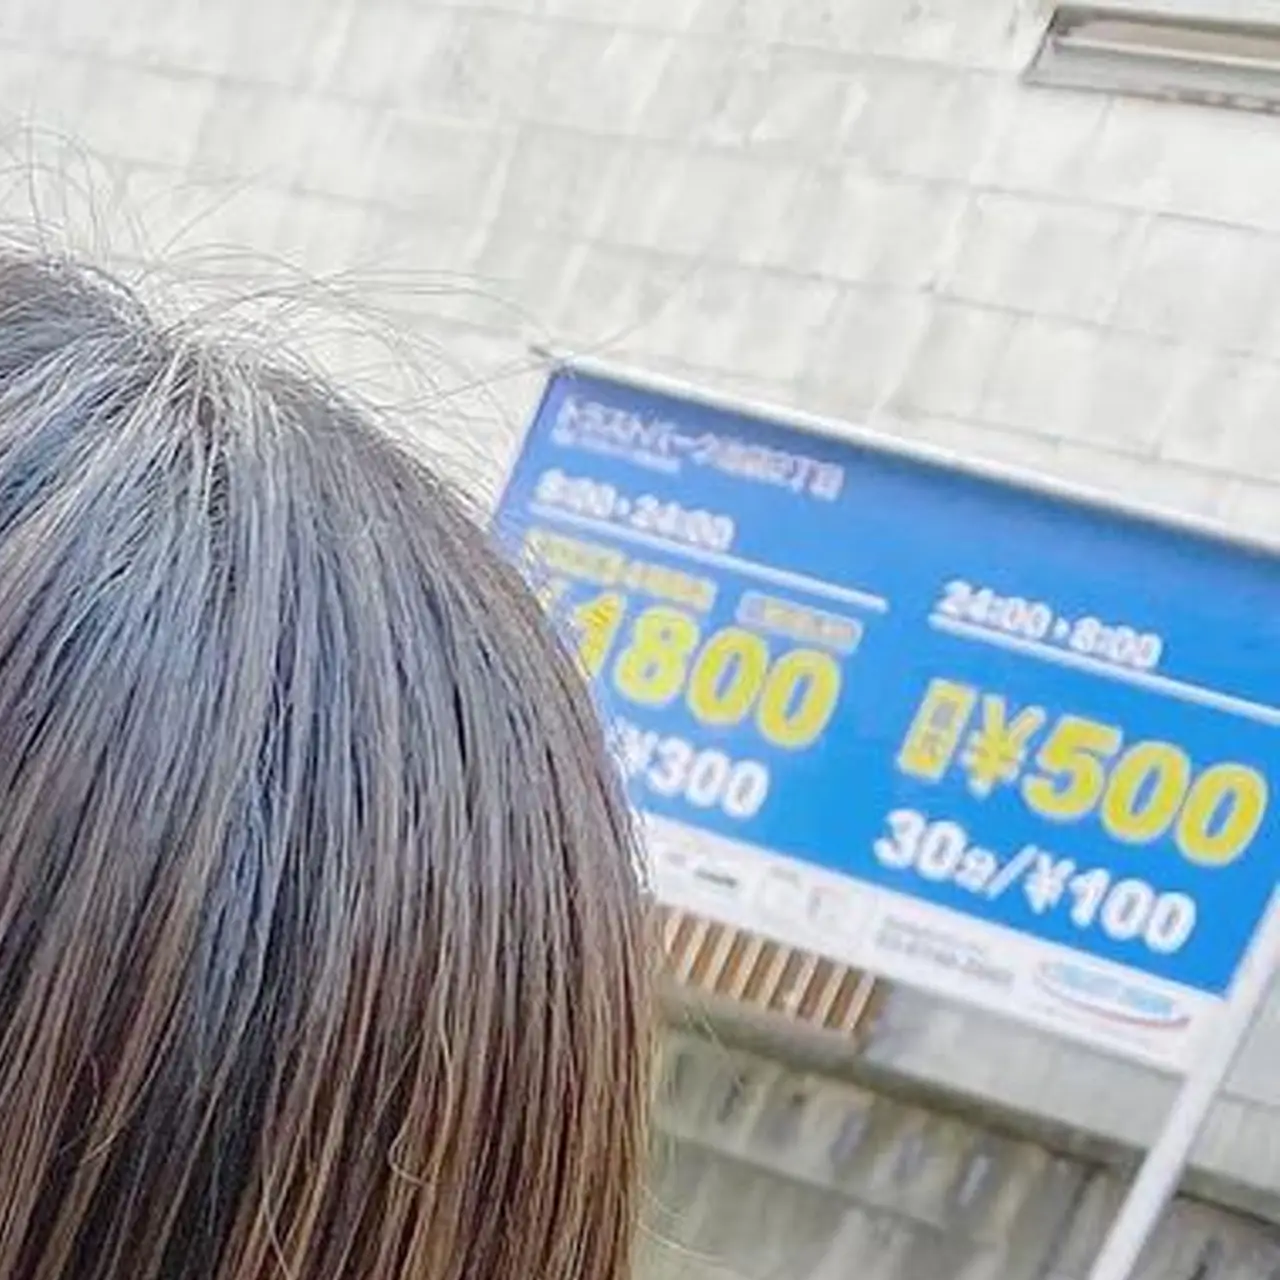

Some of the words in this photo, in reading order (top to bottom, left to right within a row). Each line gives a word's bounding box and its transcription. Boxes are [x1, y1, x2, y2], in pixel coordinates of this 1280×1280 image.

[566, 591, 842, 750] 1800
[937, 580, 1053, 640] 24:00
[960, 690, 1269, 867] ¥500
